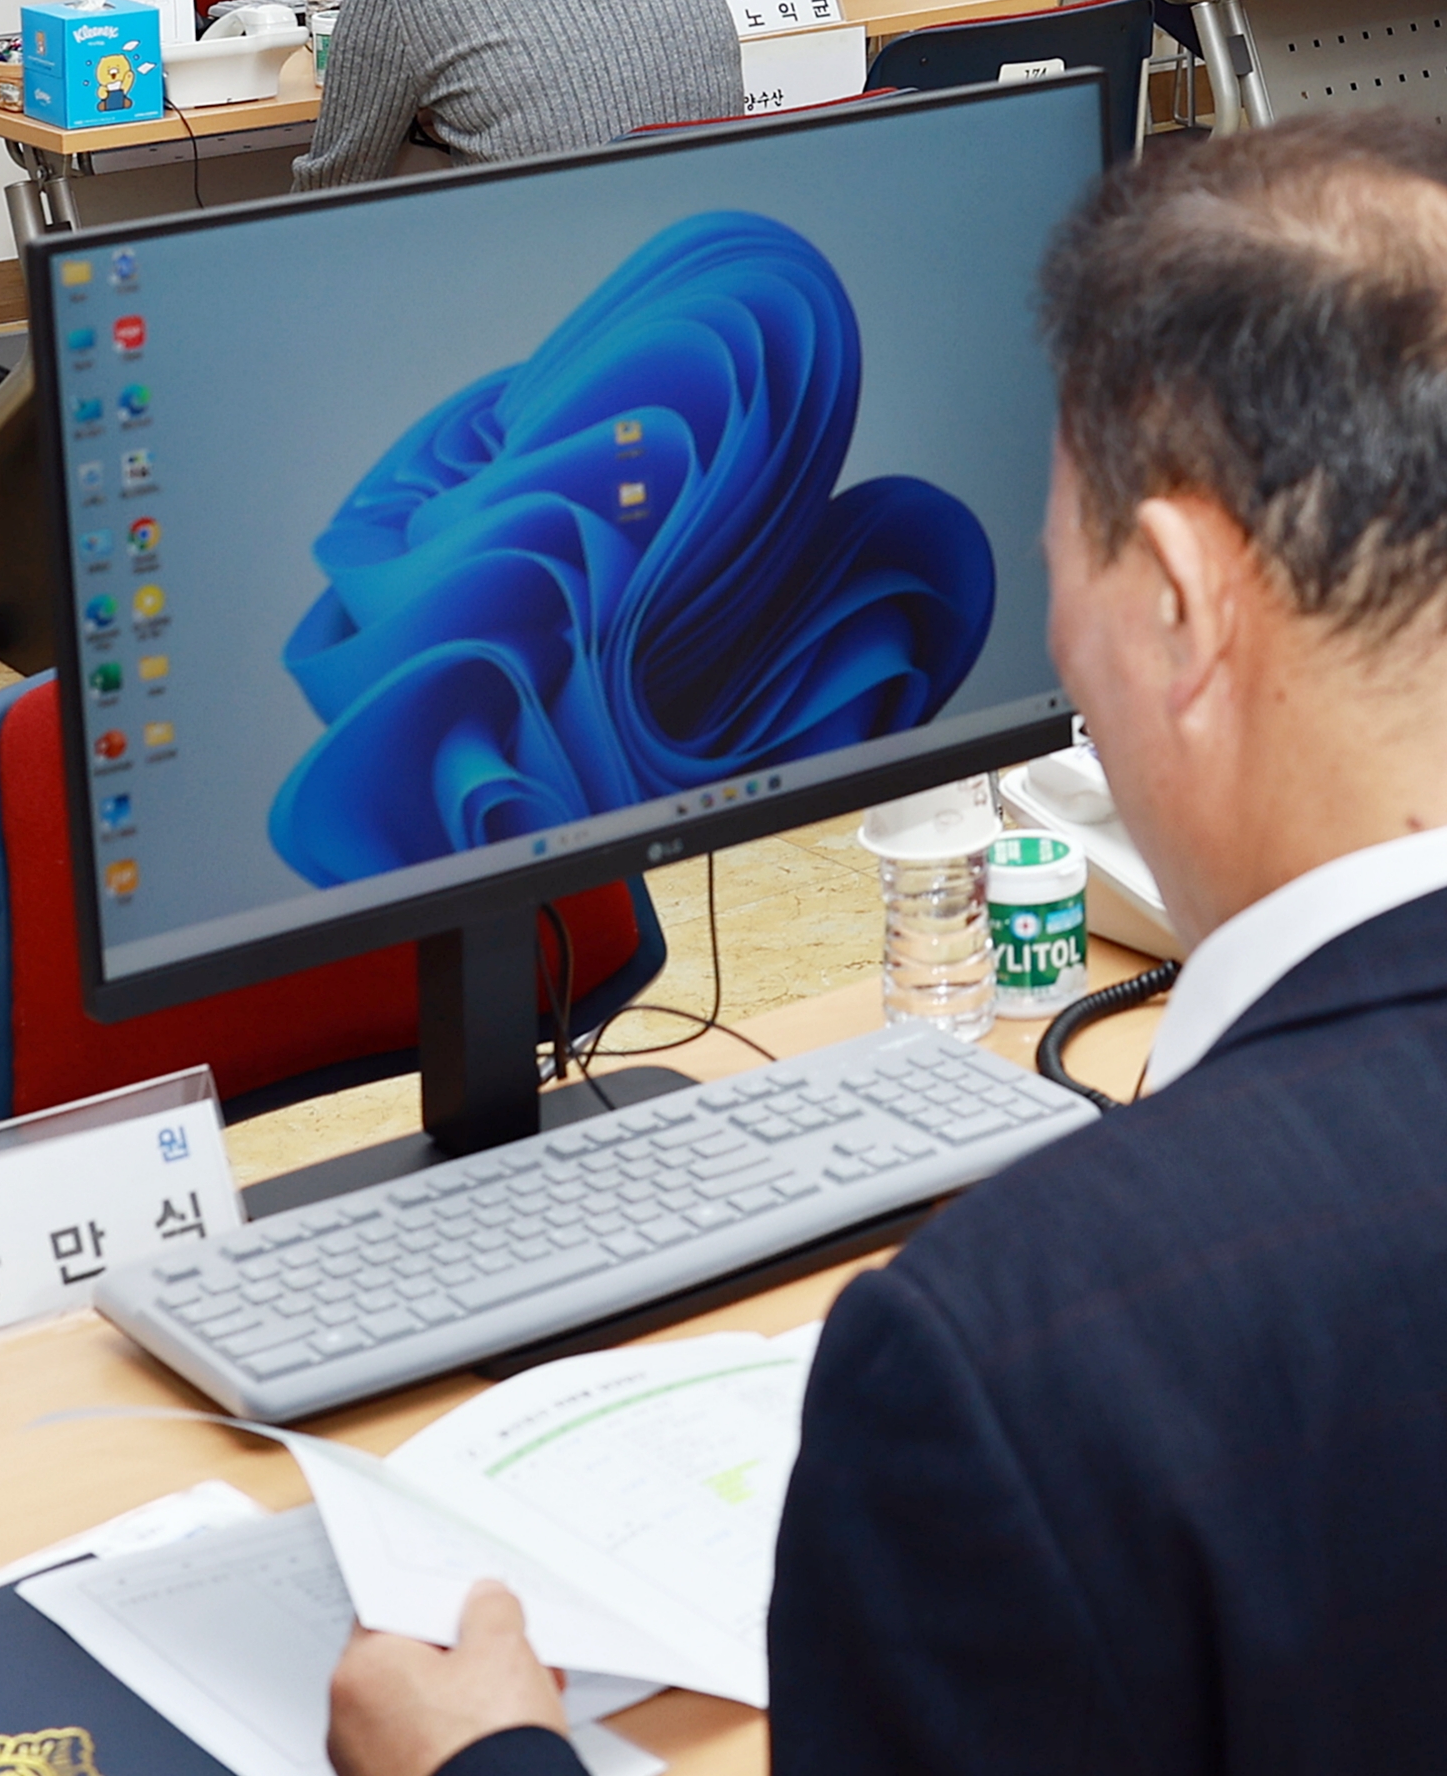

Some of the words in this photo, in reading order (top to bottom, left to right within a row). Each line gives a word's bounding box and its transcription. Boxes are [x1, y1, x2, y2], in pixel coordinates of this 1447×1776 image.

[73, 24, 119, 43] Kleenex
[991, 935, 1083, 972] YLITOL
[159, 1126, 191, 1164] 원
